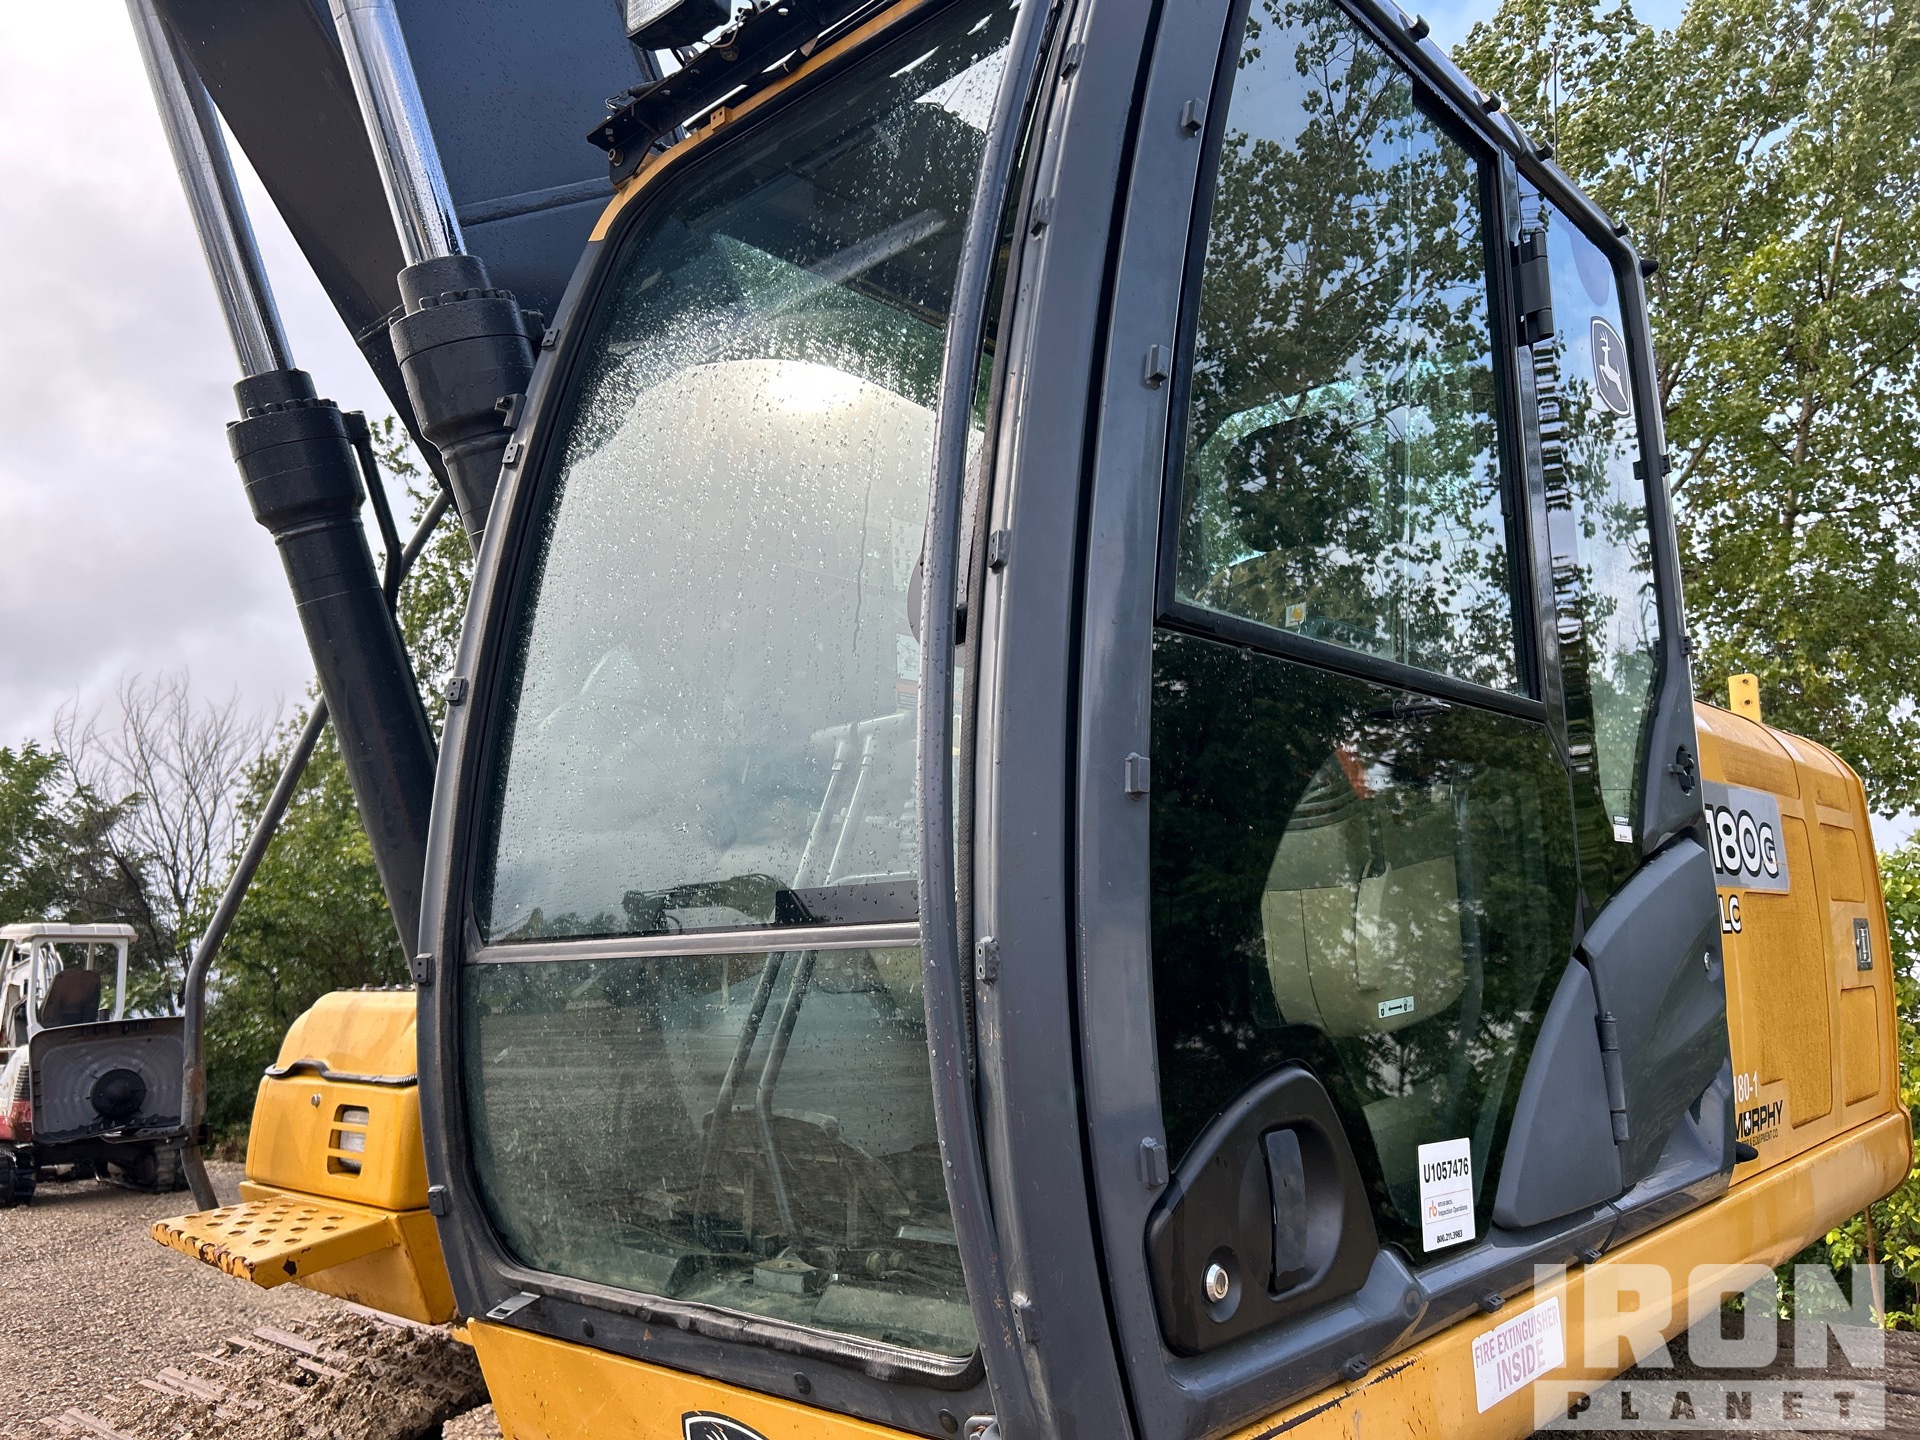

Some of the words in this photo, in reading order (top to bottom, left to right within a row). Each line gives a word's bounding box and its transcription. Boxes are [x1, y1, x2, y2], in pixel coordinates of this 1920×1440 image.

[1704, 803, 1779, 878] 180G
[1718, 894, 1742, 934] LC
[1424, 1157, 1469, 1183] U1057476
[1475, 1337, 1496, 1368] FIRE
[1497, 1305, 1559, 1355] EXTINGUISHER
[1497, 1337, 1546, 1392] INSIDE
